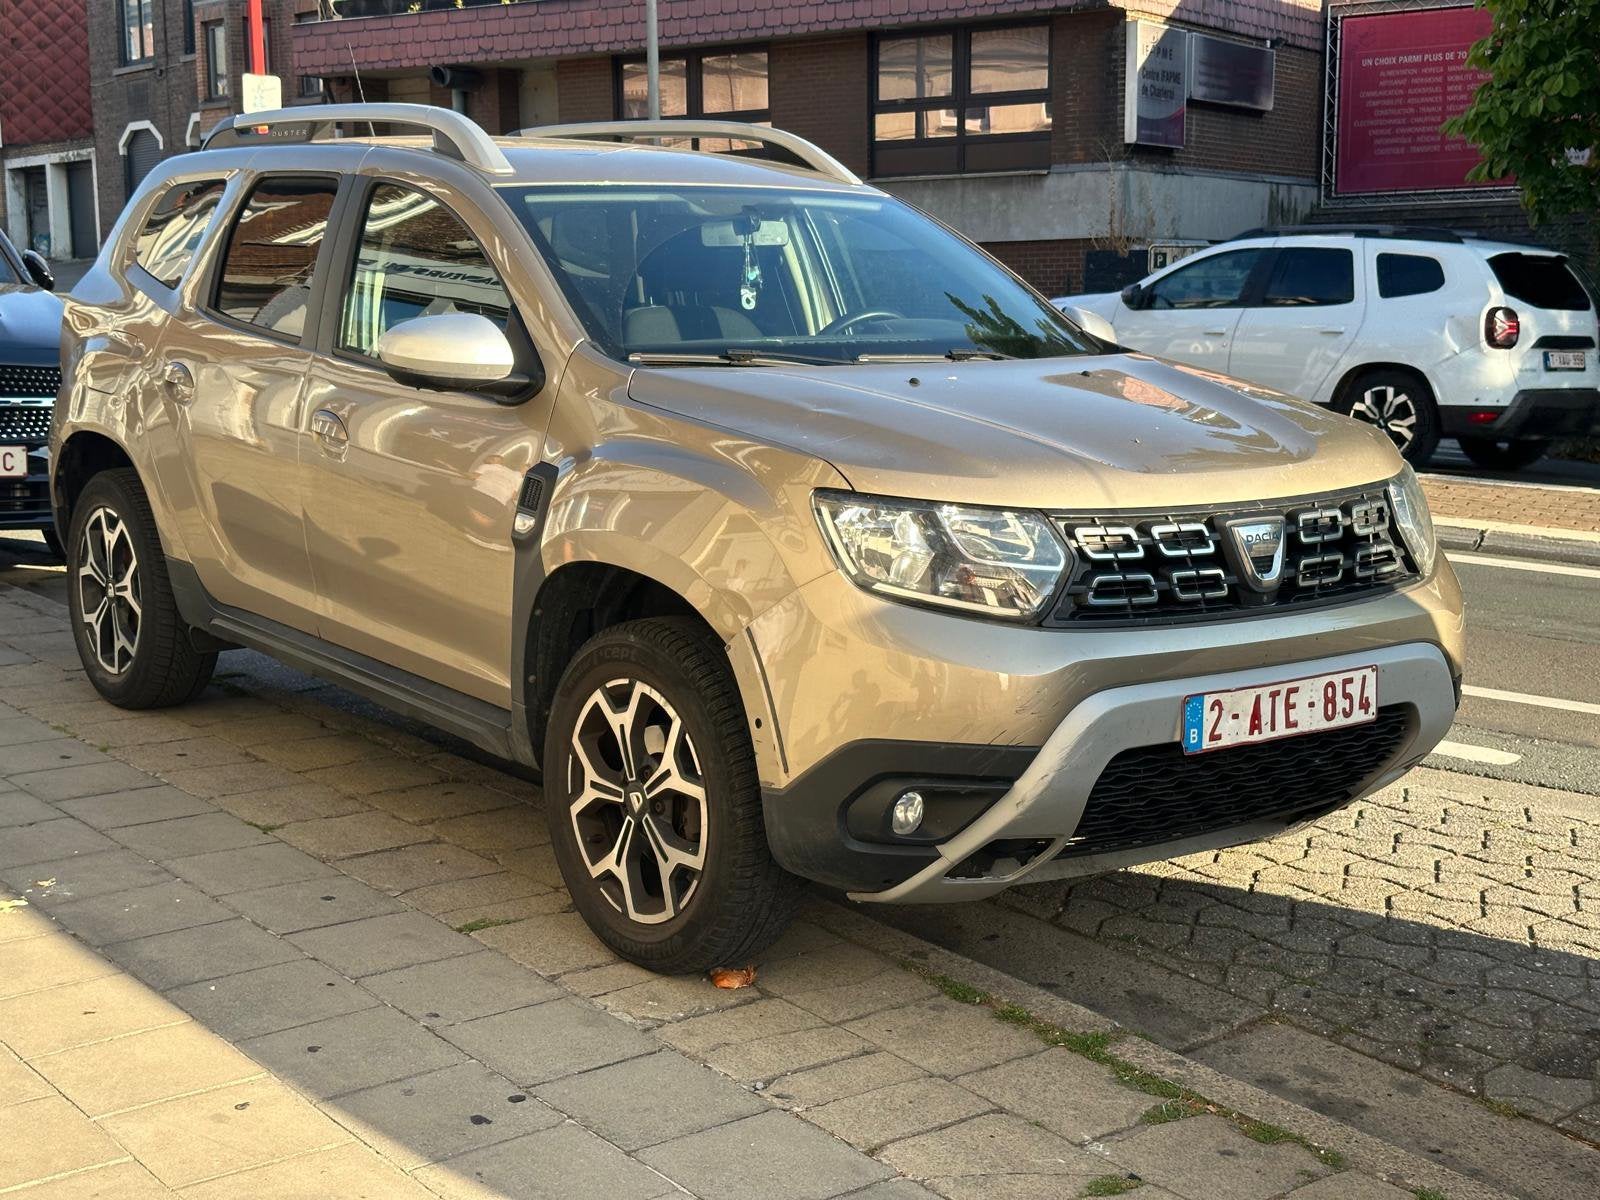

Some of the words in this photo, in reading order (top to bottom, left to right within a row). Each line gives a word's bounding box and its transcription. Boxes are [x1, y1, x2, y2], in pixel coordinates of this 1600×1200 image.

[1361, 59, 1373, 67] UN
[1374, 57, 1397, 66] CHOIX
[1398, 55, 1422, 64] PARMI
[1424, 53, 1443, 62] PLUS
[1445, 51, 1455, 60] DE
[1457, 50, 1468, 60] 70
[272, 129, 307, 137] DUSTER
[1246, 531, 1280, 543] DACIA
[1208, 674, 1371, 743] 2-ATE-854
[1190, 728, 1198, 744] B
